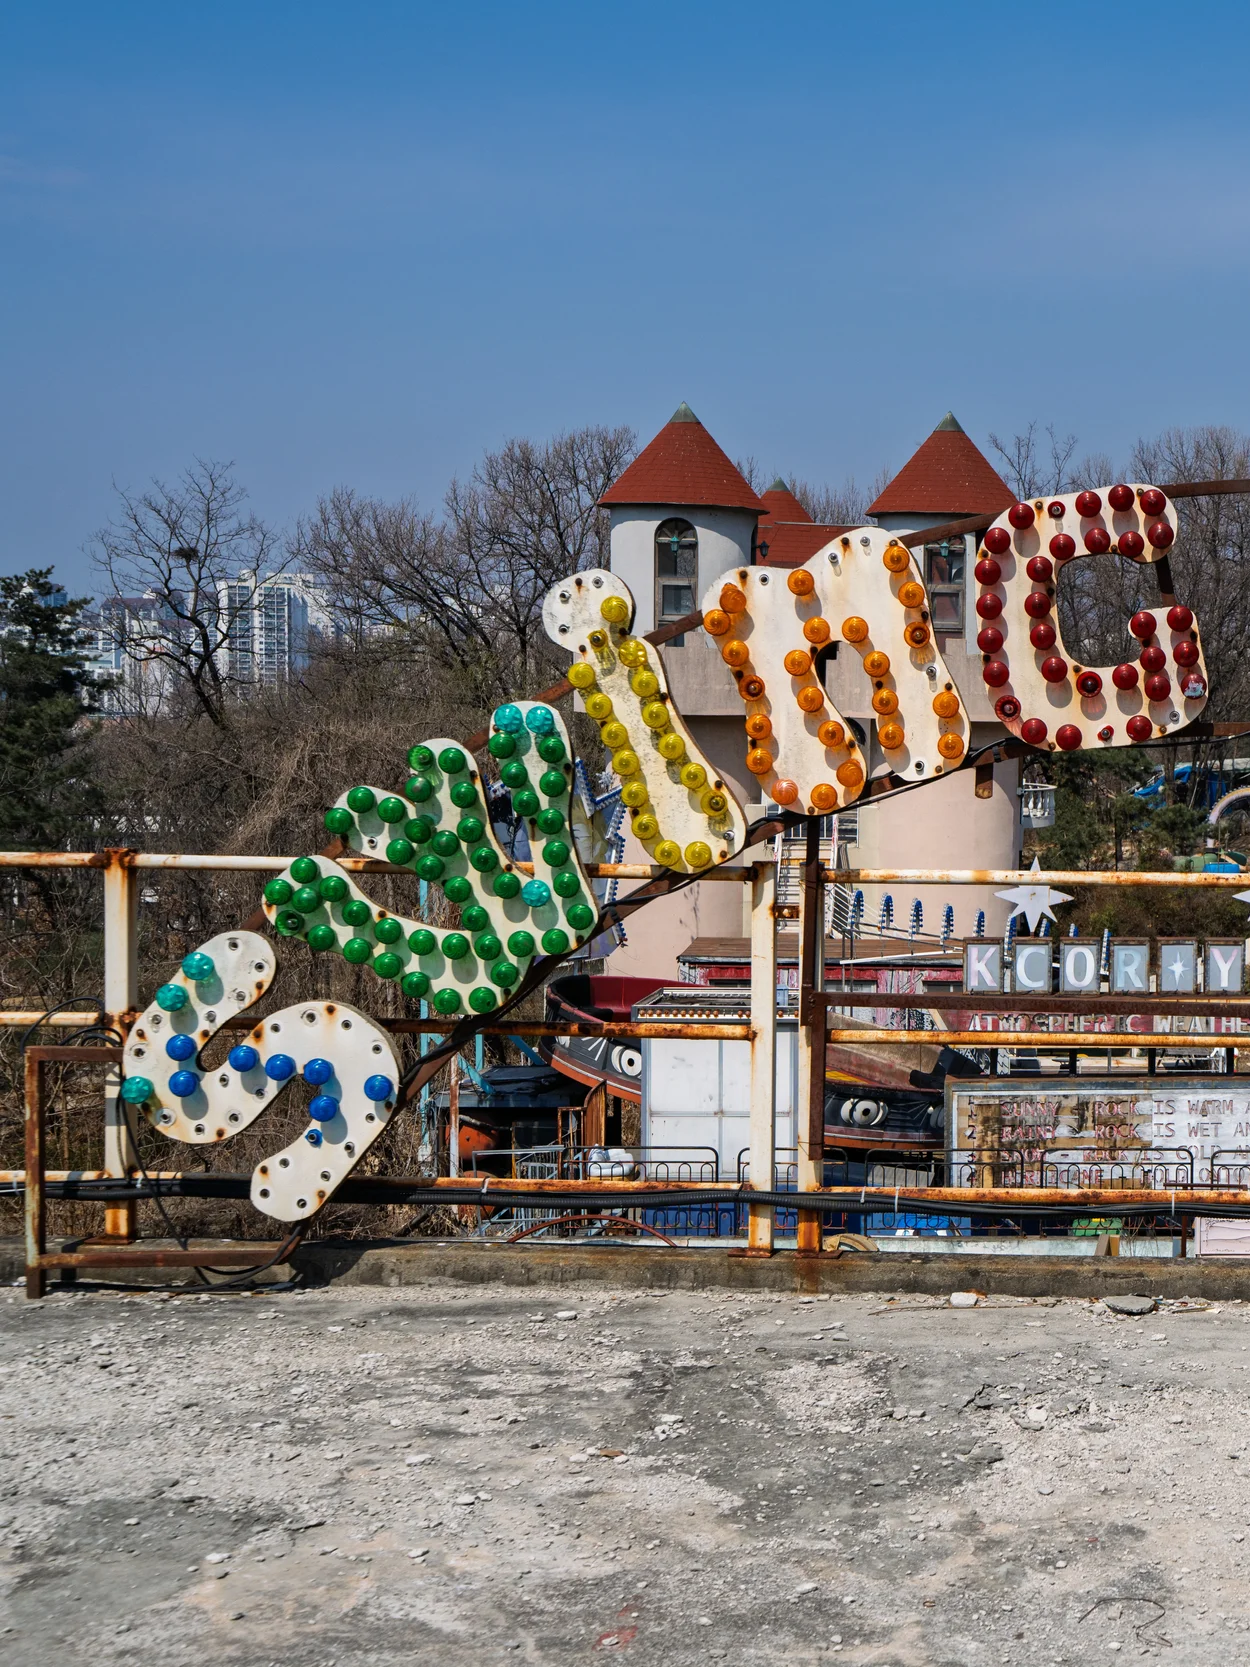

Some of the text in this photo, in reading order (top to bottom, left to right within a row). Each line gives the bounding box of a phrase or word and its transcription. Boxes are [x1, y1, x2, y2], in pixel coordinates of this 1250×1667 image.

[968, 1013, 1142, 1033] ATMOSPHERIC
[1001, 1101, 1060, 1117] SUNNY
[1095, 1100, 1140, 1116] ROCK
[1153, 1099, 1176, 1115] IS
[1187, 1099, 1234, 1115] WARM
[1002, 1124, 1056, 1140] RAINY
[1095, 1123, 1141, 1139] ROCK
[1153, 1122, 1176, 1138] IS
[1187, 1122, 1223, 1138] WET
[1083, 1147, 1129, 1161] ROCK
[1140, 1145, 1164, 1161] IS
[1176, 1145, 1221, 1160] COLD
[1001, 1169, 1105, 1185] HRICANE
